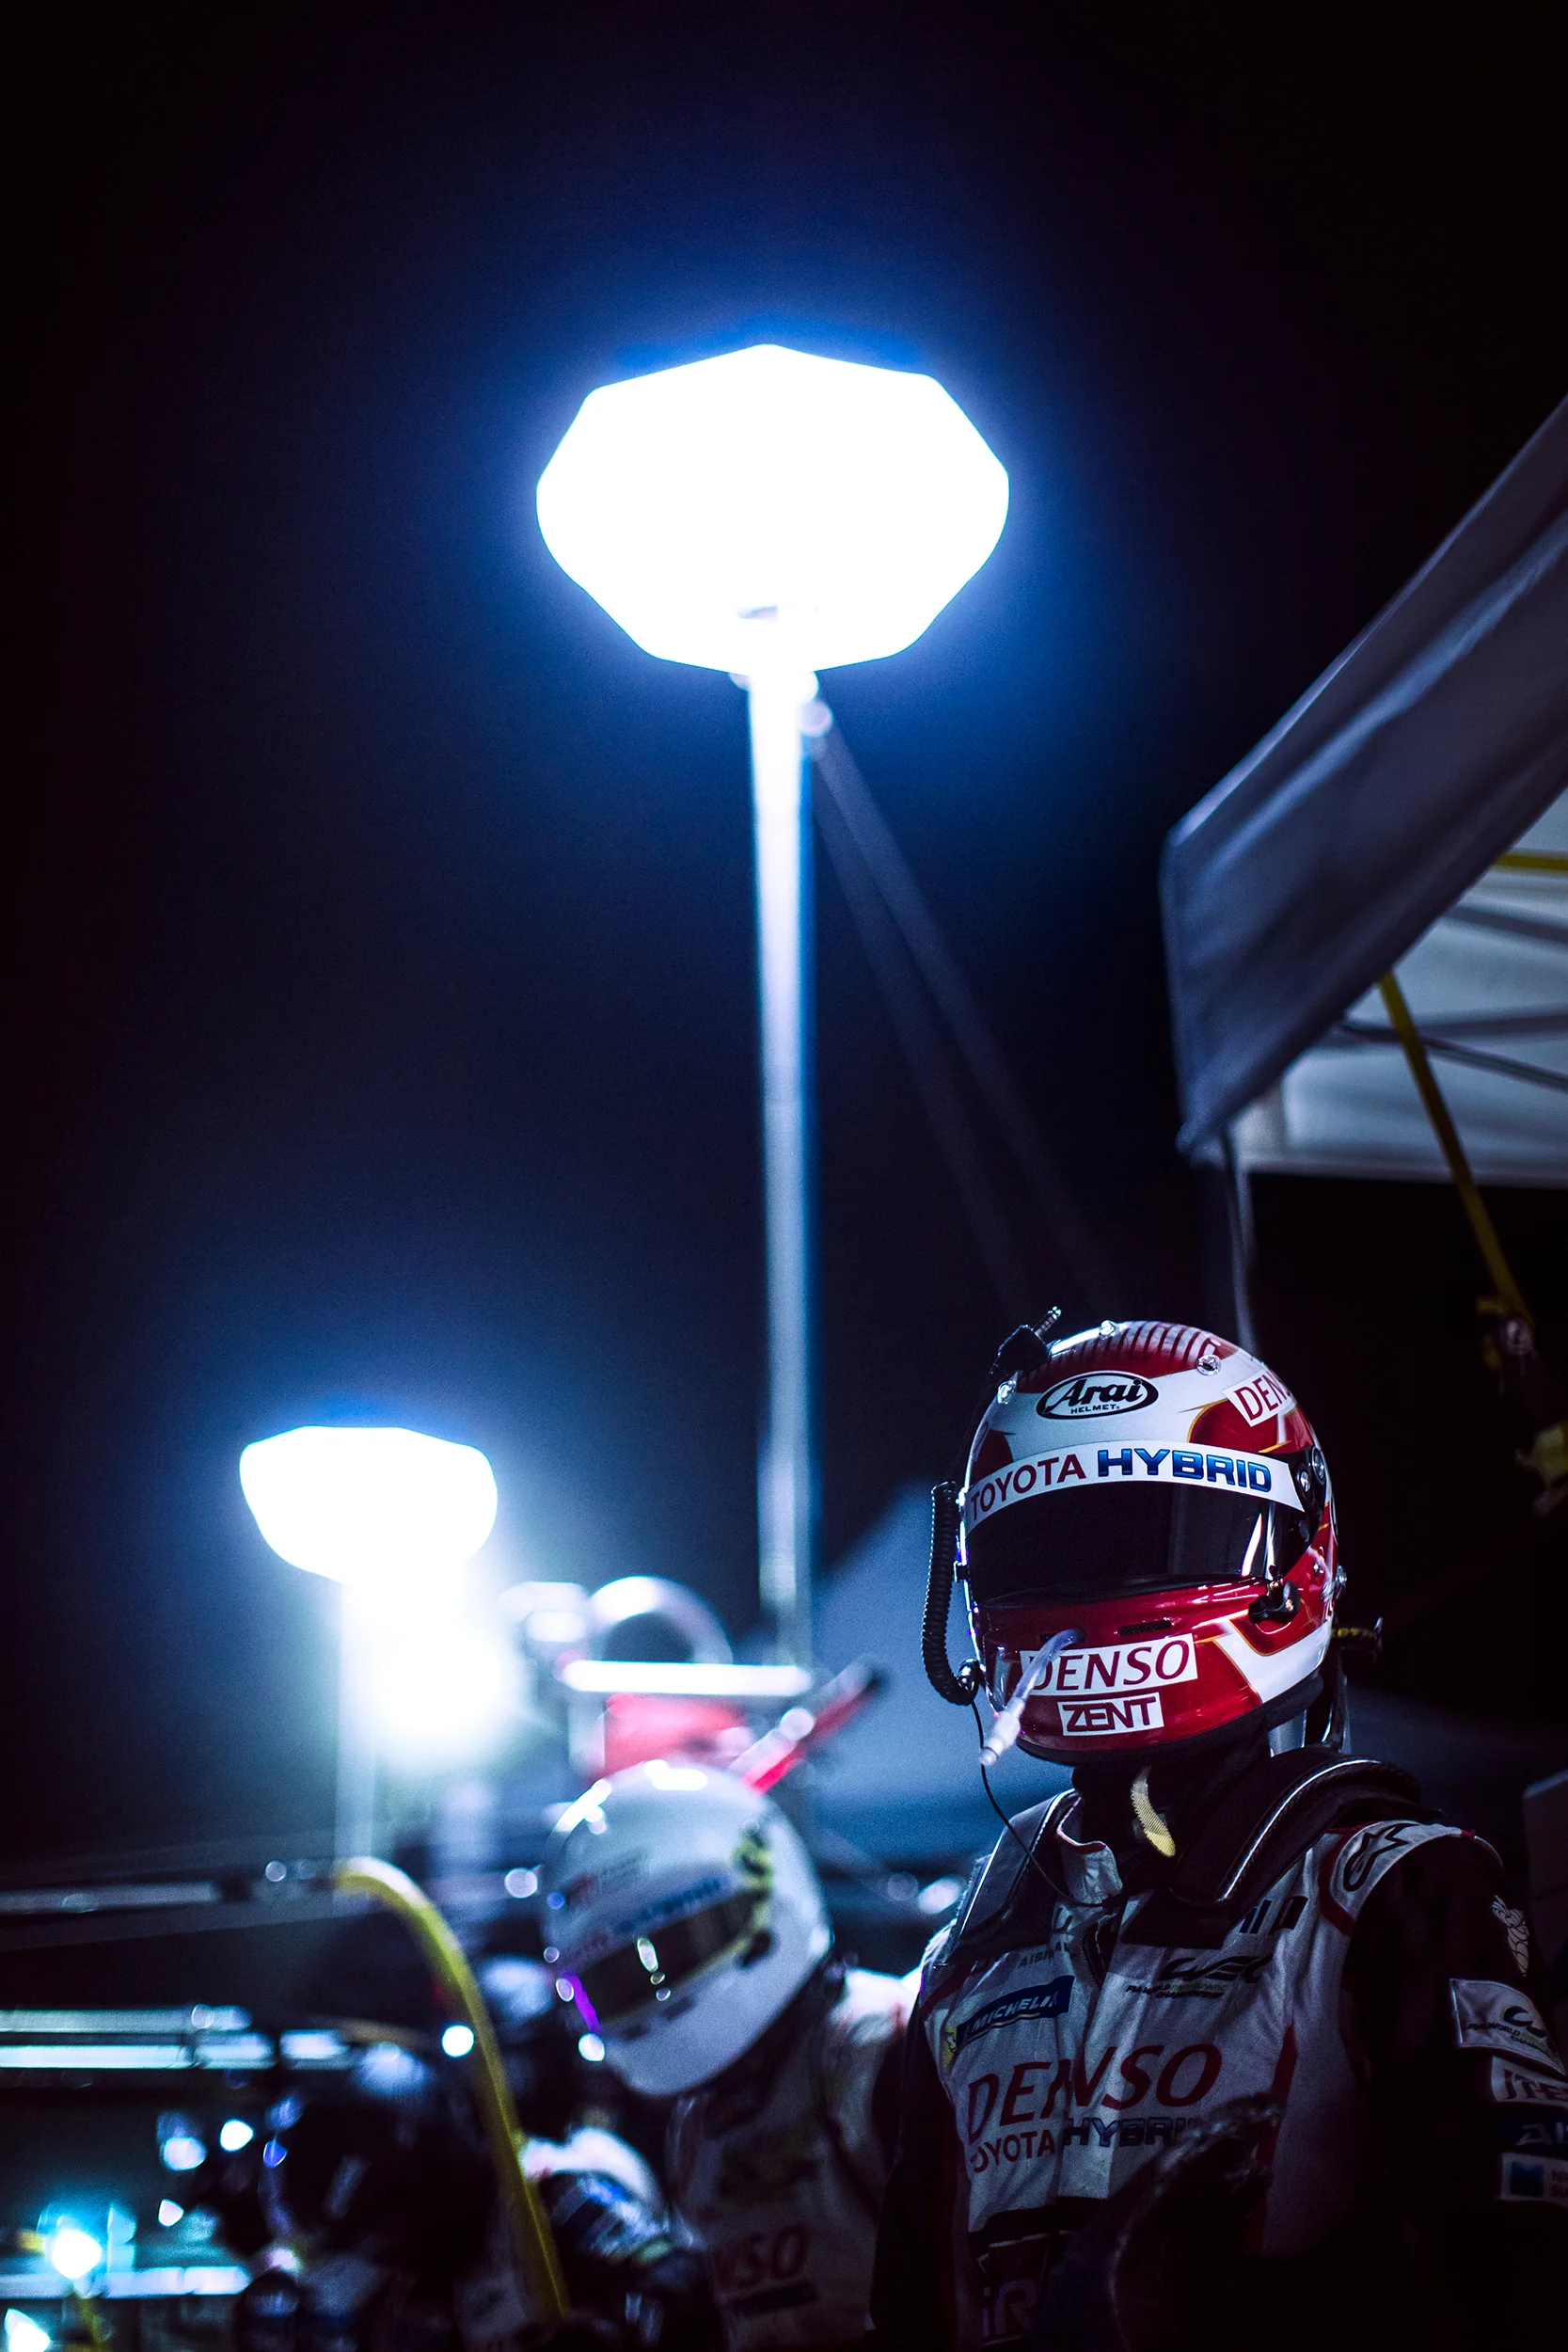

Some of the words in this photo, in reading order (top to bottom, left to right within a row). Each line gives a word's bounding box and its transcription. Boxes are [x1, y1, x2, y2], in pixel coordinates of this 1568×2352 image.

[1041, 1378, 1144, 1413] Arai
[1070, 1404, 1117, 1414] HELMET
[970, 1454, 1087, 1522] TOYOTA
[1097, 1448, 1273, 1493] HYBRID
[1062, 1696, 1156, 1732] ZENT
[970, 1991, 1059, 2031] MICHELIN
[968, 2043, 1222, 2145] DENSO
[970, 2130, 1055, 2173] OYOTA
